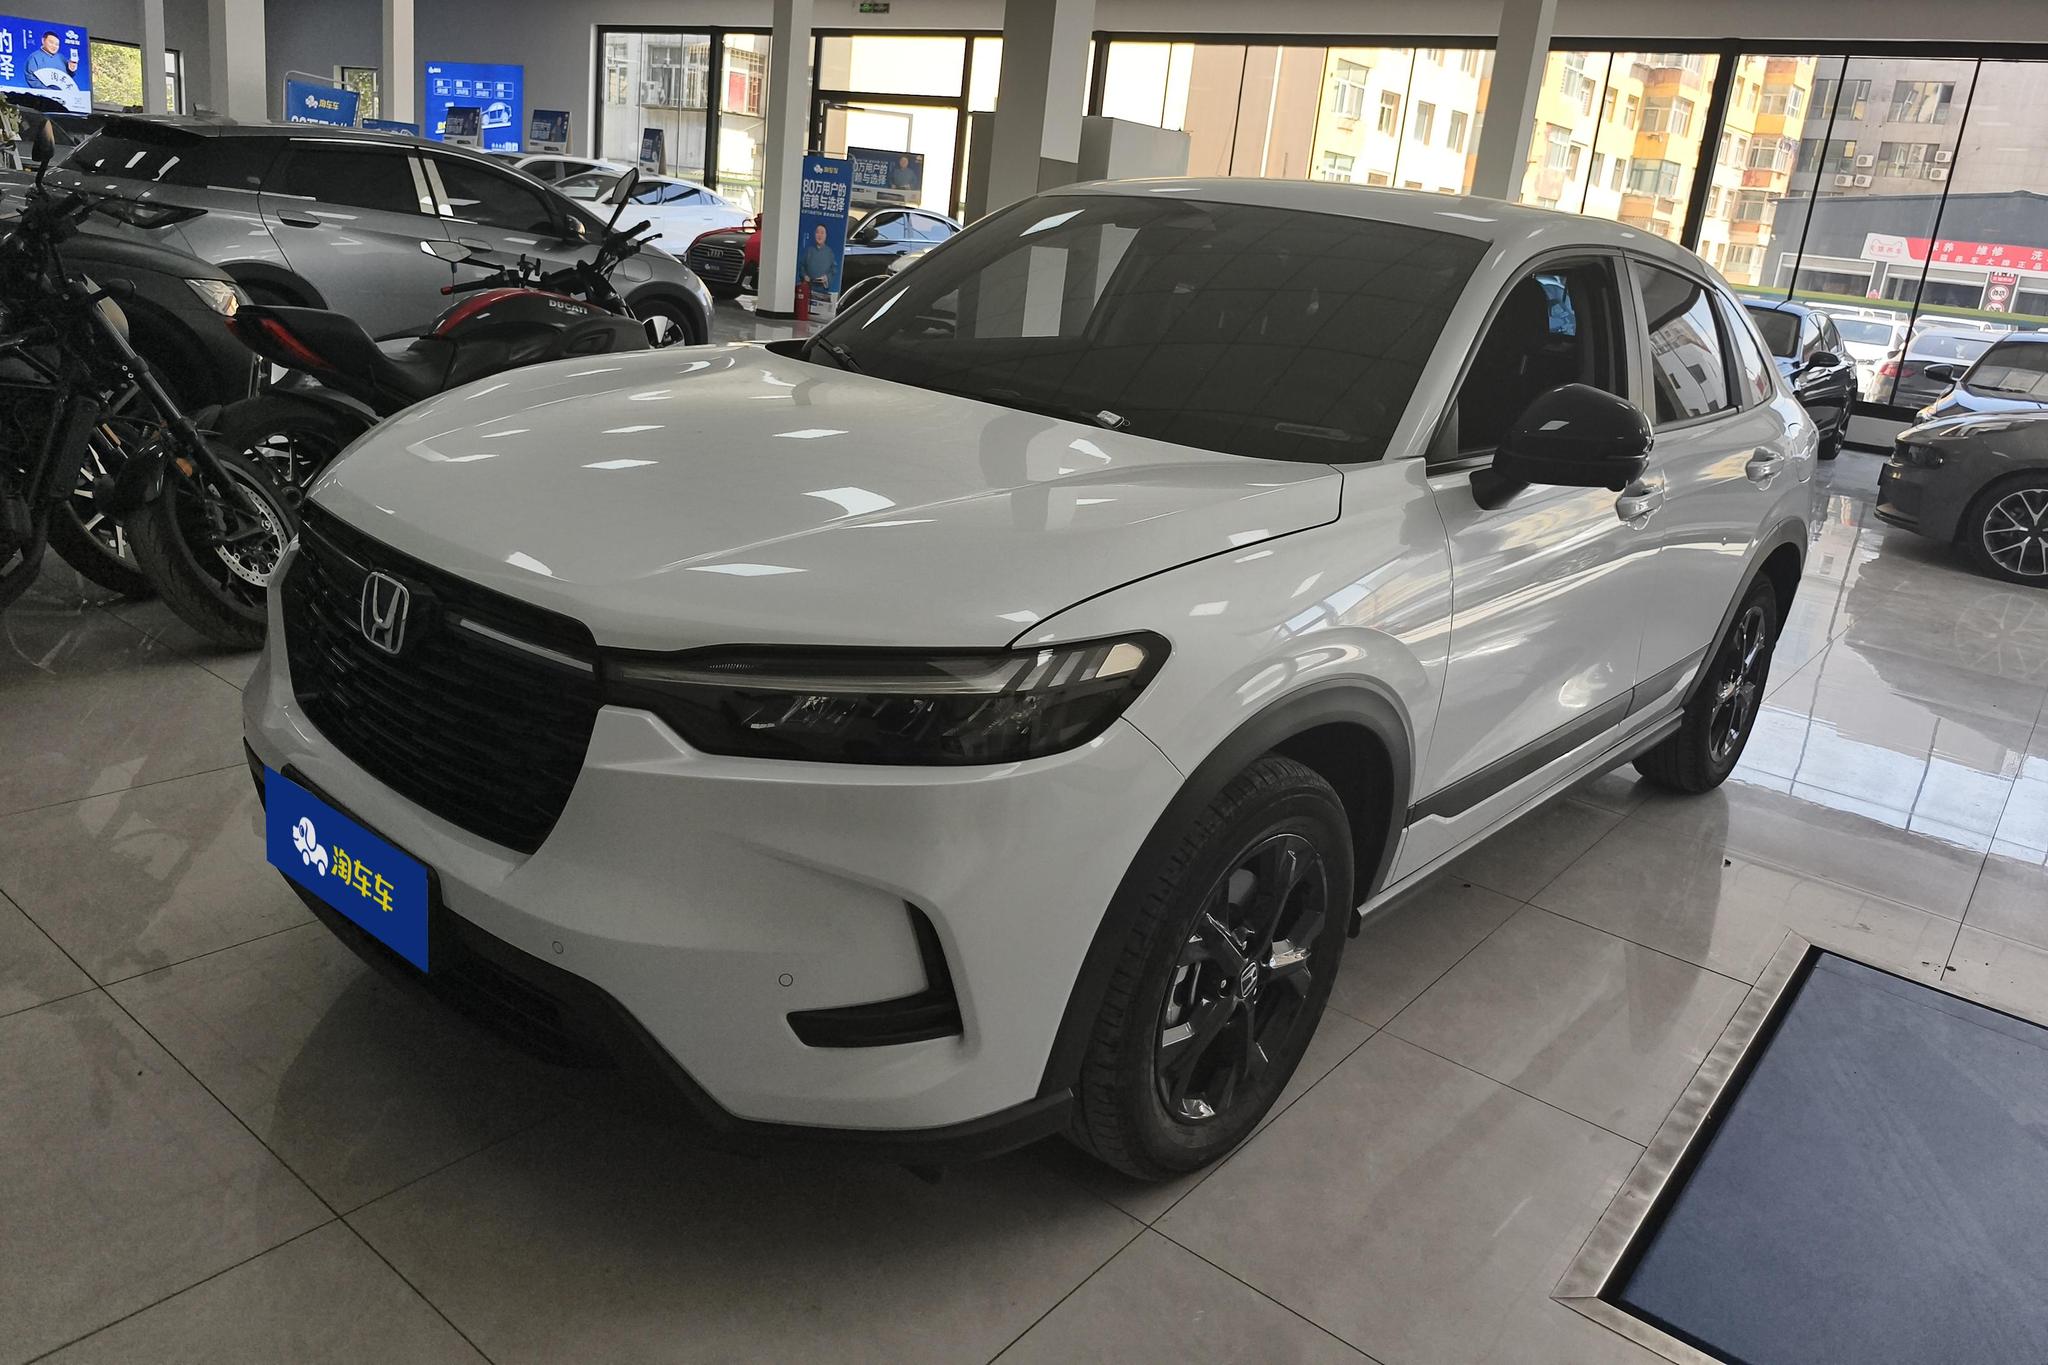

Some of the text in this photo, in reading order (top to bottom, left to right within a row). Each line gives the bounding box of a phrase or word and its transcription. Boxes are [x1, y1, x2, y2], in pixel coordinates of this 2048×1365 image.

[0, 28, 13, 53] 的
[853, 162, 888, 175] 0万用户的
[854, 172, 887, 185] 赖与选择
[802, 179, 847, 197] 80万用户的
[802, 193, 845, 213] 信赖与选择
[2030, 250, 2048, 261] 洗
[549, 300, 588, 315] DUCATI
[331, 845, 395, 912] 淘车车
